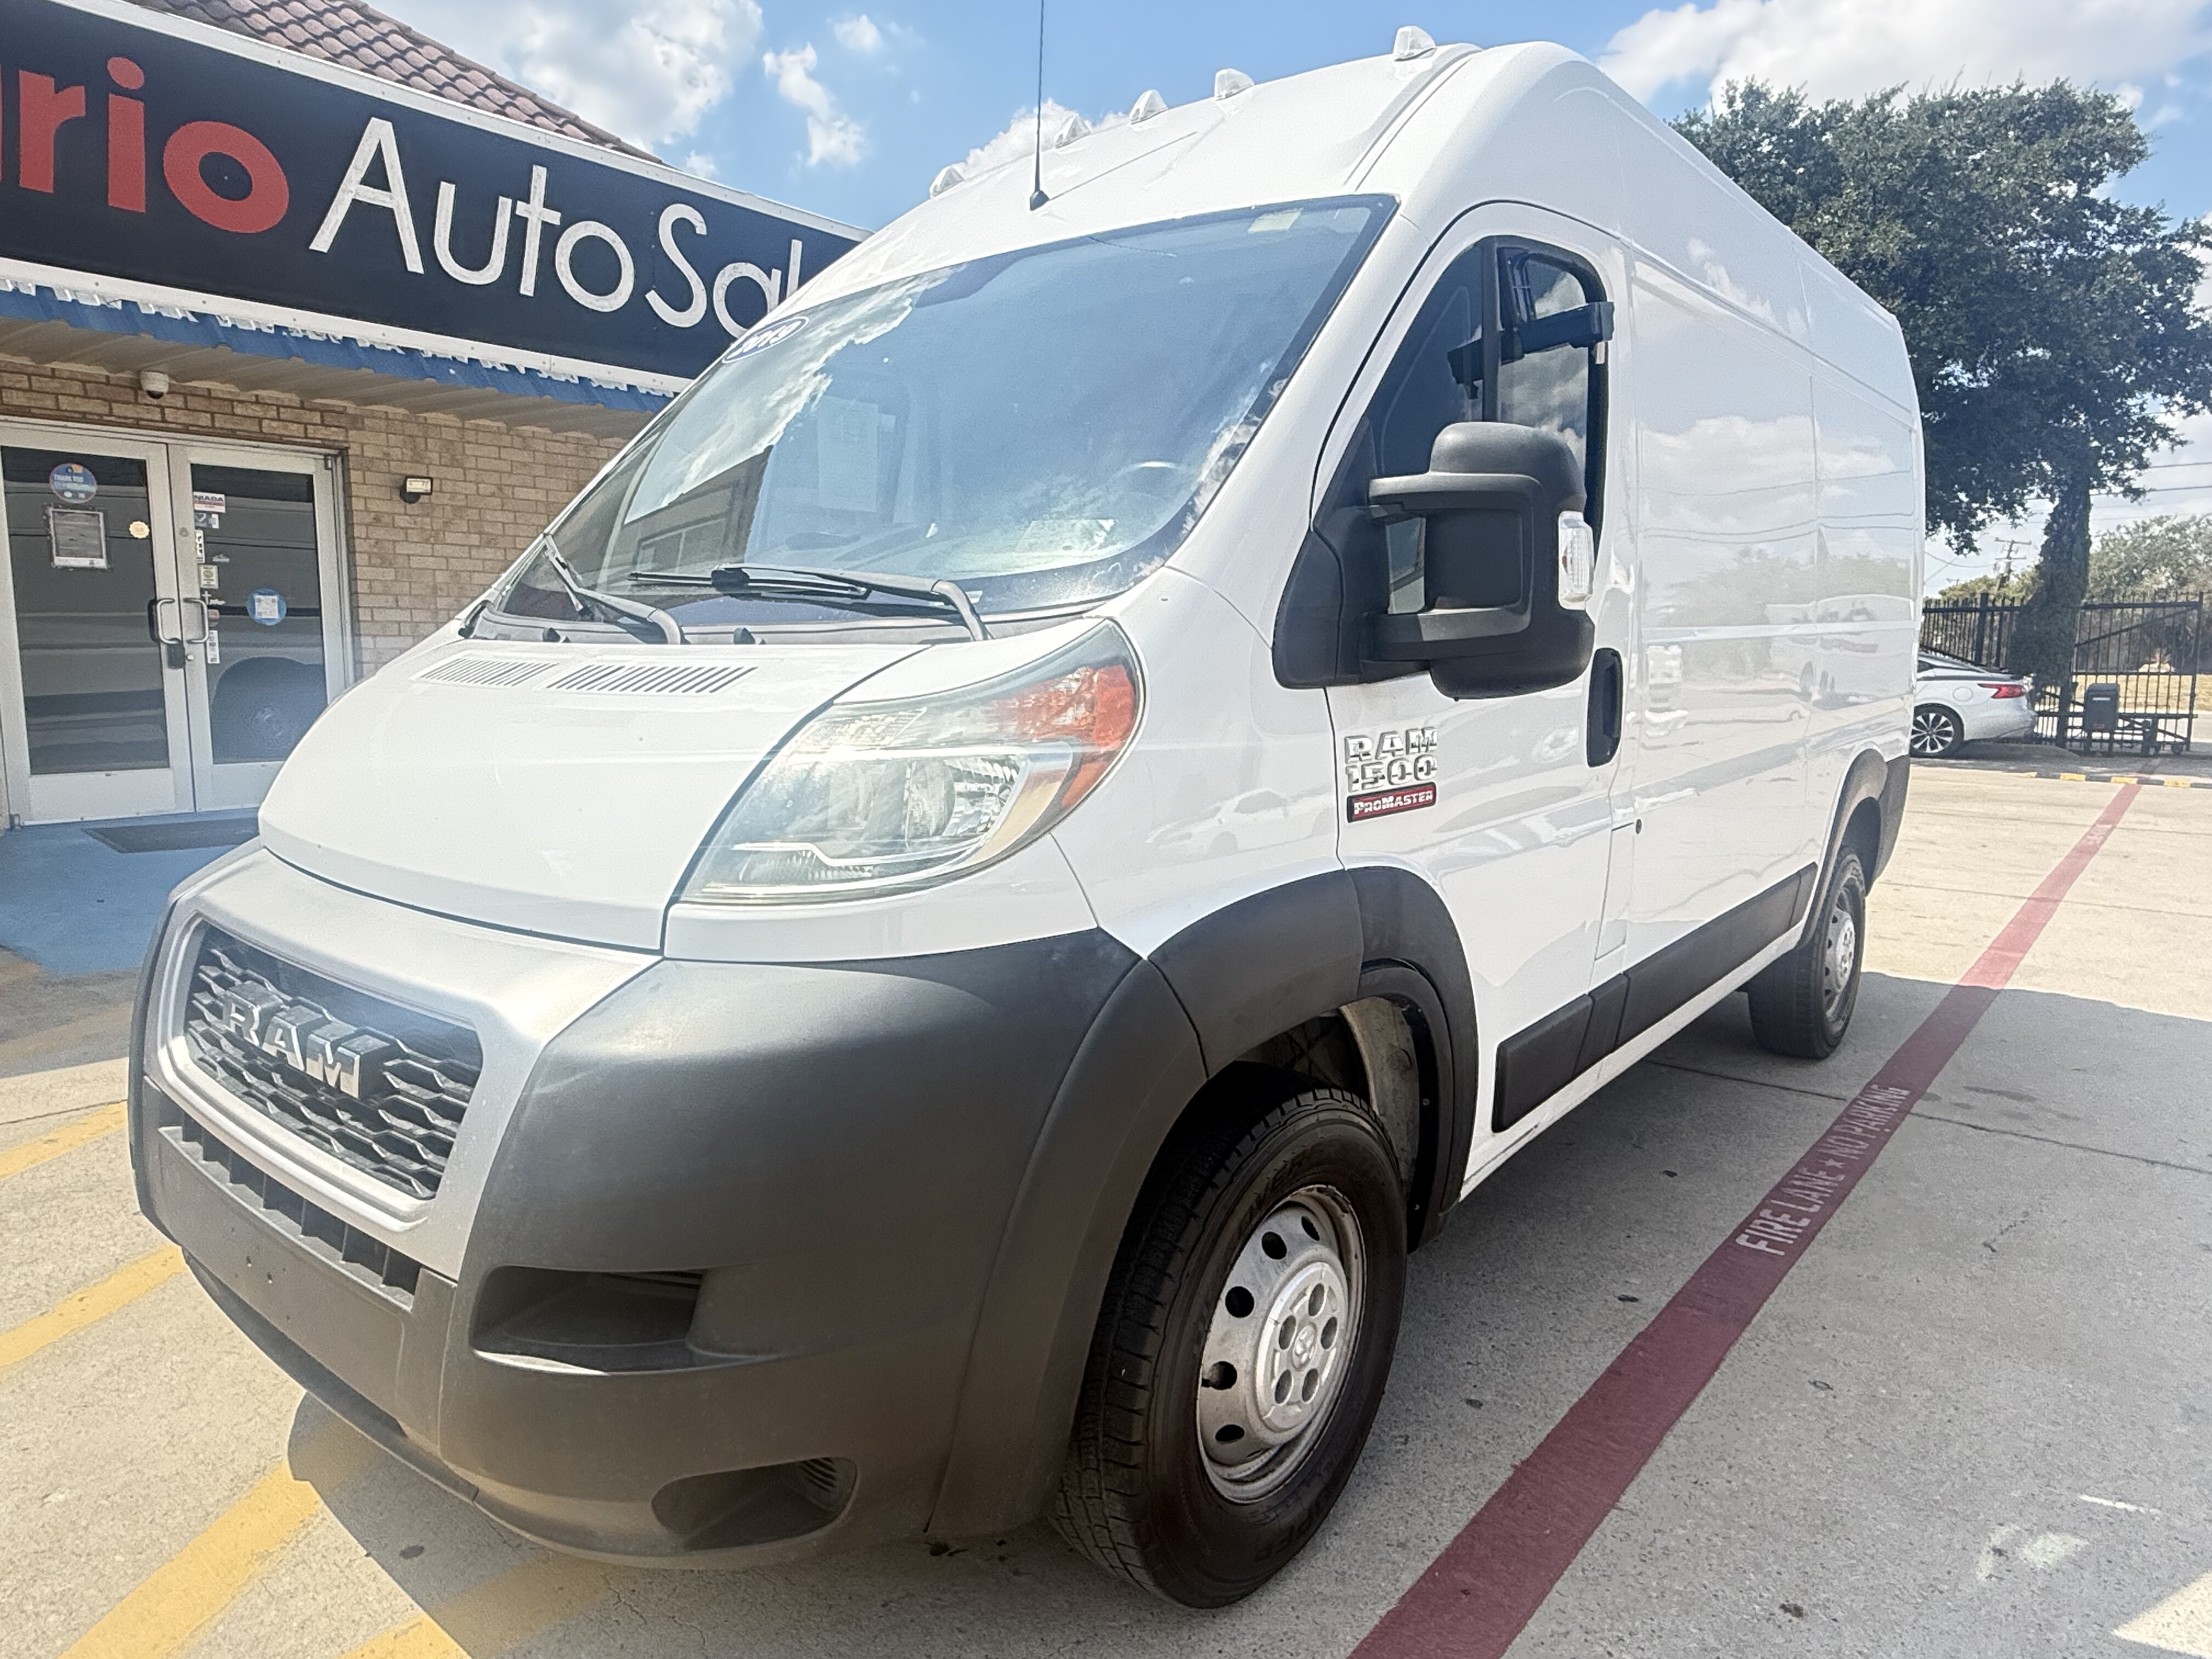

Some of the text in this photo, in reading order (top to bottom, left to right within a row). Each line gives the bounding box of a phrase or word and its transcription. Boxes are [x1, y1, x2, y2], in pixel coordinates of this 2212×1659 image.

[0, 57, 803, 339] rio Auto Sal
[1344, 727, 1437, 763] RAM
[1346, 754, 1437, 793] 1500
[222, 982, 388, 1098] RAM
[1735, 1084, 1910, 1256] FIRE LANE NO PARKING
